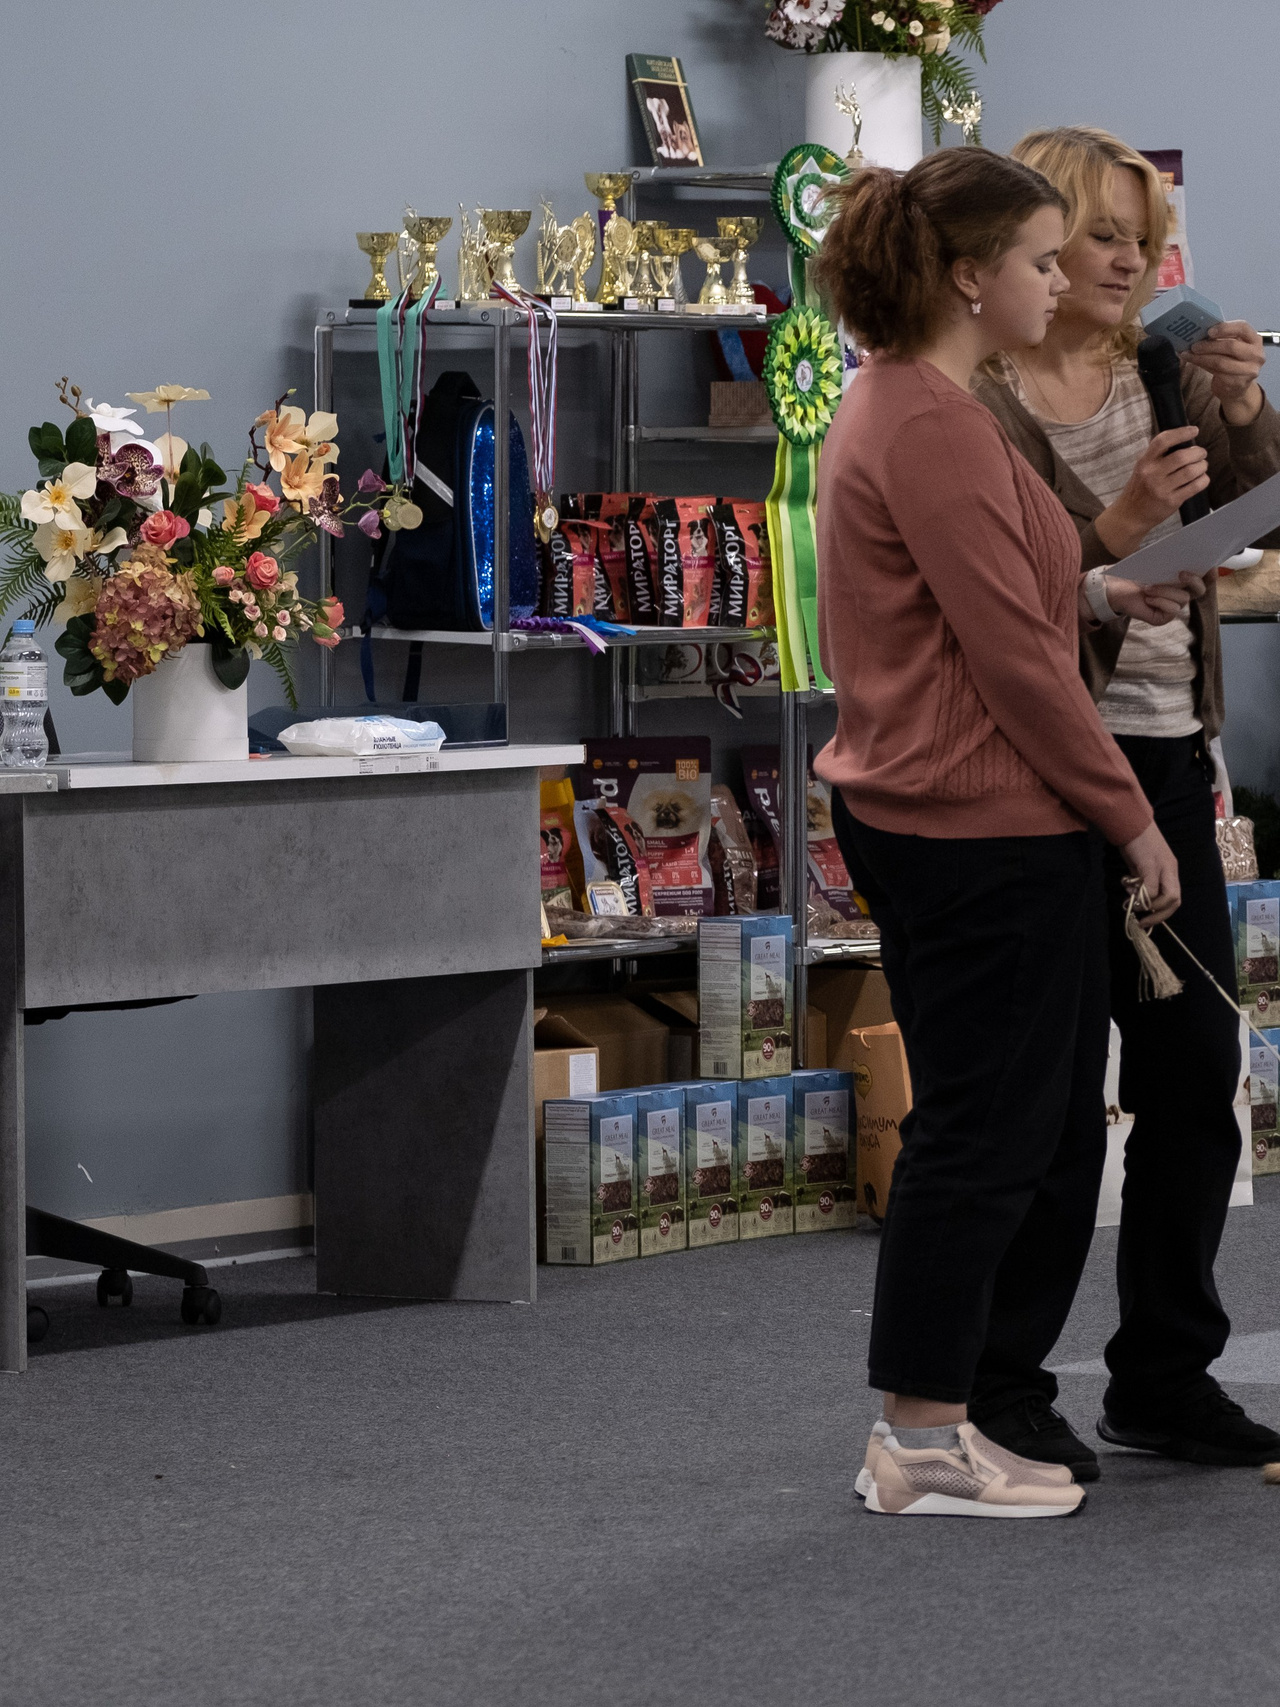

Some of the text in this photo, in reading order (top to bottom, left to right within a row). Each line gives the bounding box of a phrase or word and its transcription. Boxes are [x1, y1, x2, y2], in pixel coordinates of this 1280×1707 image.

[1166, 315, 1201, 342] JBL
[551, 528, 569, 614] МИРАТОР
[663, 518, 680, 617] МИРАТОРГ
[721, 521, 745, 617] МИРАТОРГ
[677, 760, 697, 769] 100%
[678, 769, 697, 780] BIO
